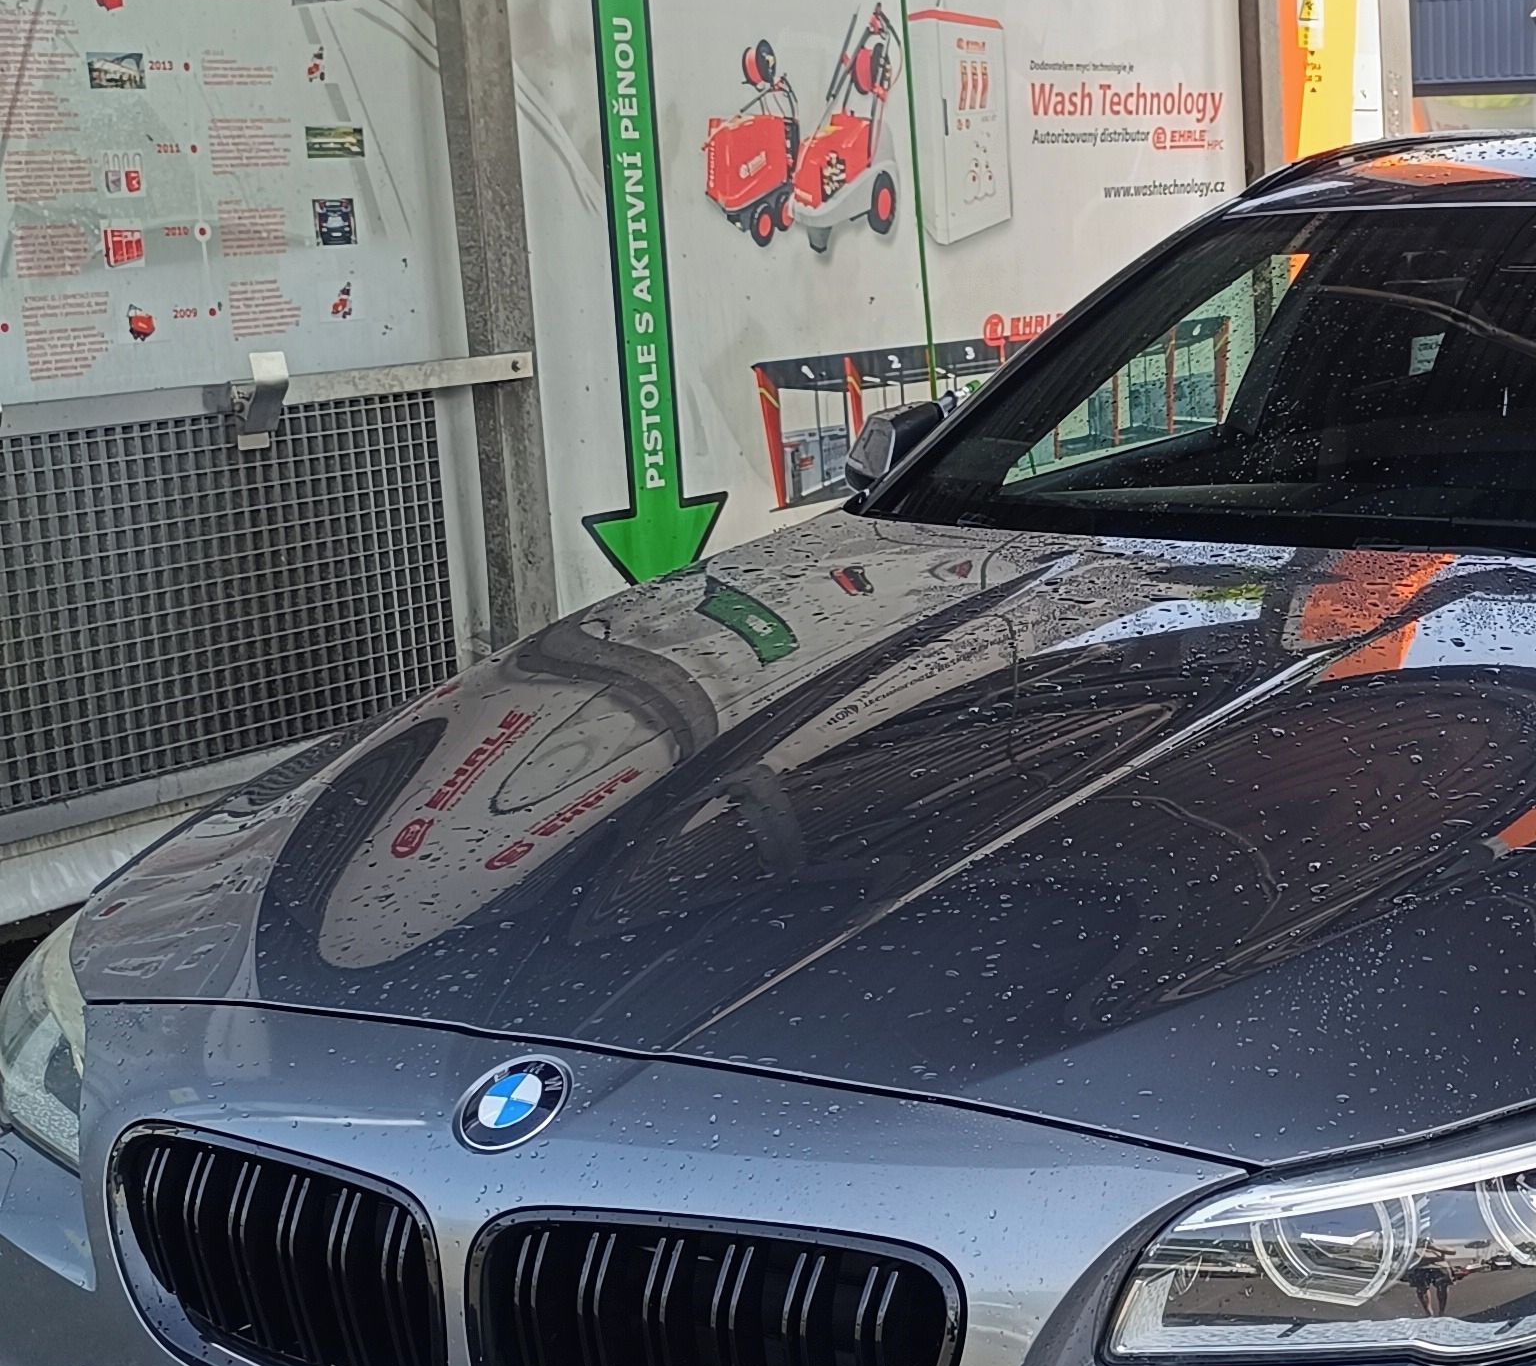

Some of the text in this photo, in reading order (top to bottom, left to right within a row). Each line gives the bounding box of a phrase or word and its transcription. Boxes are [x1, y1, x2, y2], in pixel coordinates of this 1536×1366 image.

[148, 60, 174, 72] 2013
[1031, 82, 1223, 124] Wash Technology
[1032, 128, 1098, 147] Autorizovaný
[1100, 128, 1150, 143] distributor
[1169, 130, 1206, 143] EHRLE
[1207, 139, 1224, 150] HPC
[156, 143, 181, 154] 2011
[1104, 178, 1226, 198] www.washtechnology.cz
[612, 17, 666, 489] PISTOLE S AKTIVNÍ PĚNOU
[172, 308, 198, 319] 2009
[1011, 313, 1064, 336] EHR
[887, 355, 902, 368] 2
[964, 346, 976, 360] 3
